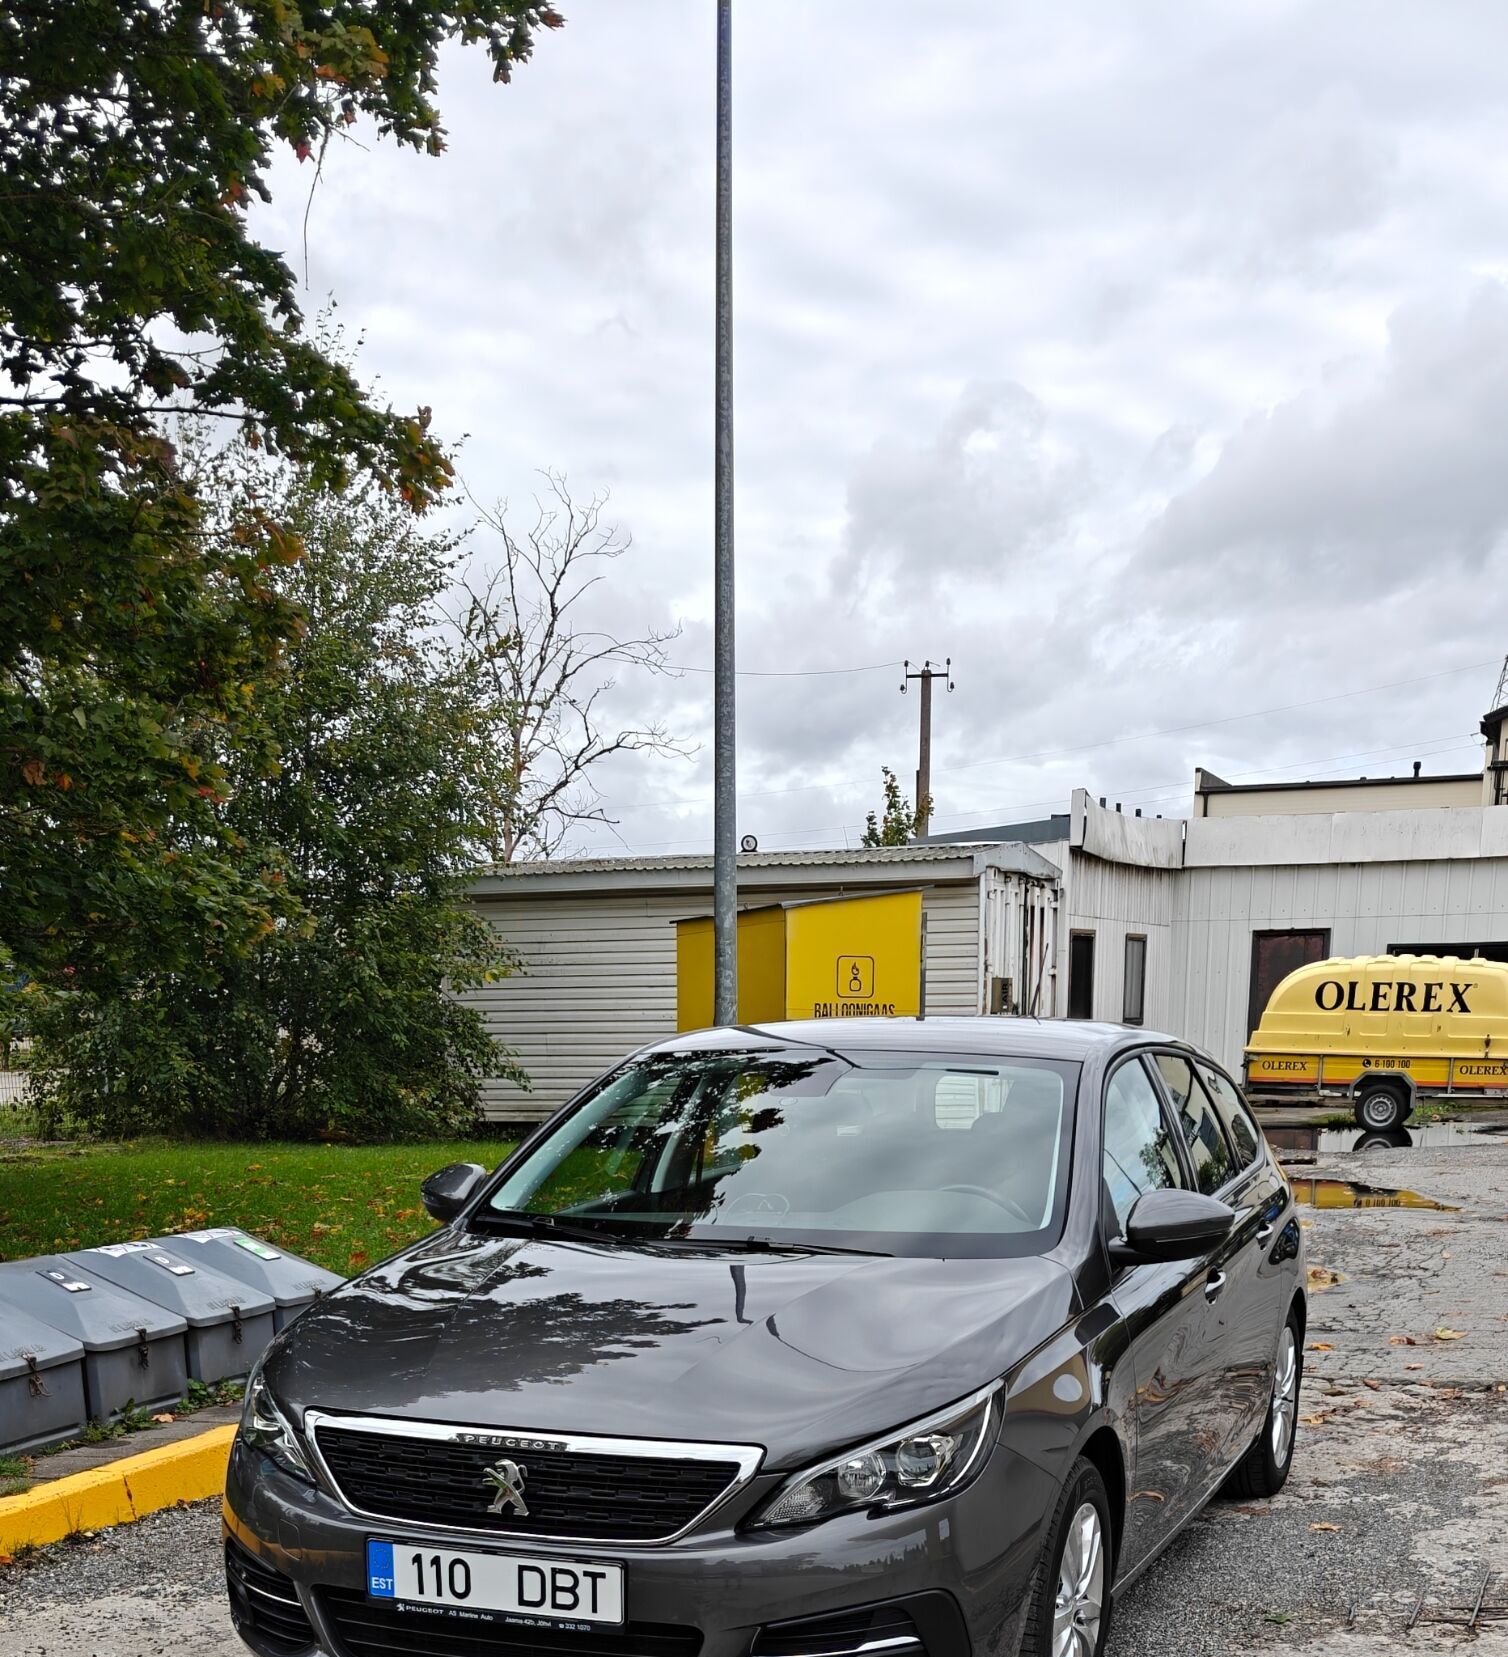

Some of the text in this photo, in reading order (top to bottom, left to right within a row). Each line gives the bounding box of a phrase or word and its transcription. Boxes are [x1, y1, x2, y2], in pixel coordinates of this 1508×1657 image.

[1315, 981, 1473, 1013] OLEREX
[1262, 1060, 1308, 1071] OLEREX
[1374, 1059, 1380, 1068] 6
[1398, 1059, 1411, 1069] 100
[1459, 1064, 1508, 1076] OLEREX
[464, 1435, 558, 1450] PEUGEOT
[372, 1577, 394, 1590] EST
[411, 1553, 606, 1614] 110 DBT
[406, 1605, 444, 1614] PEUGEOT
